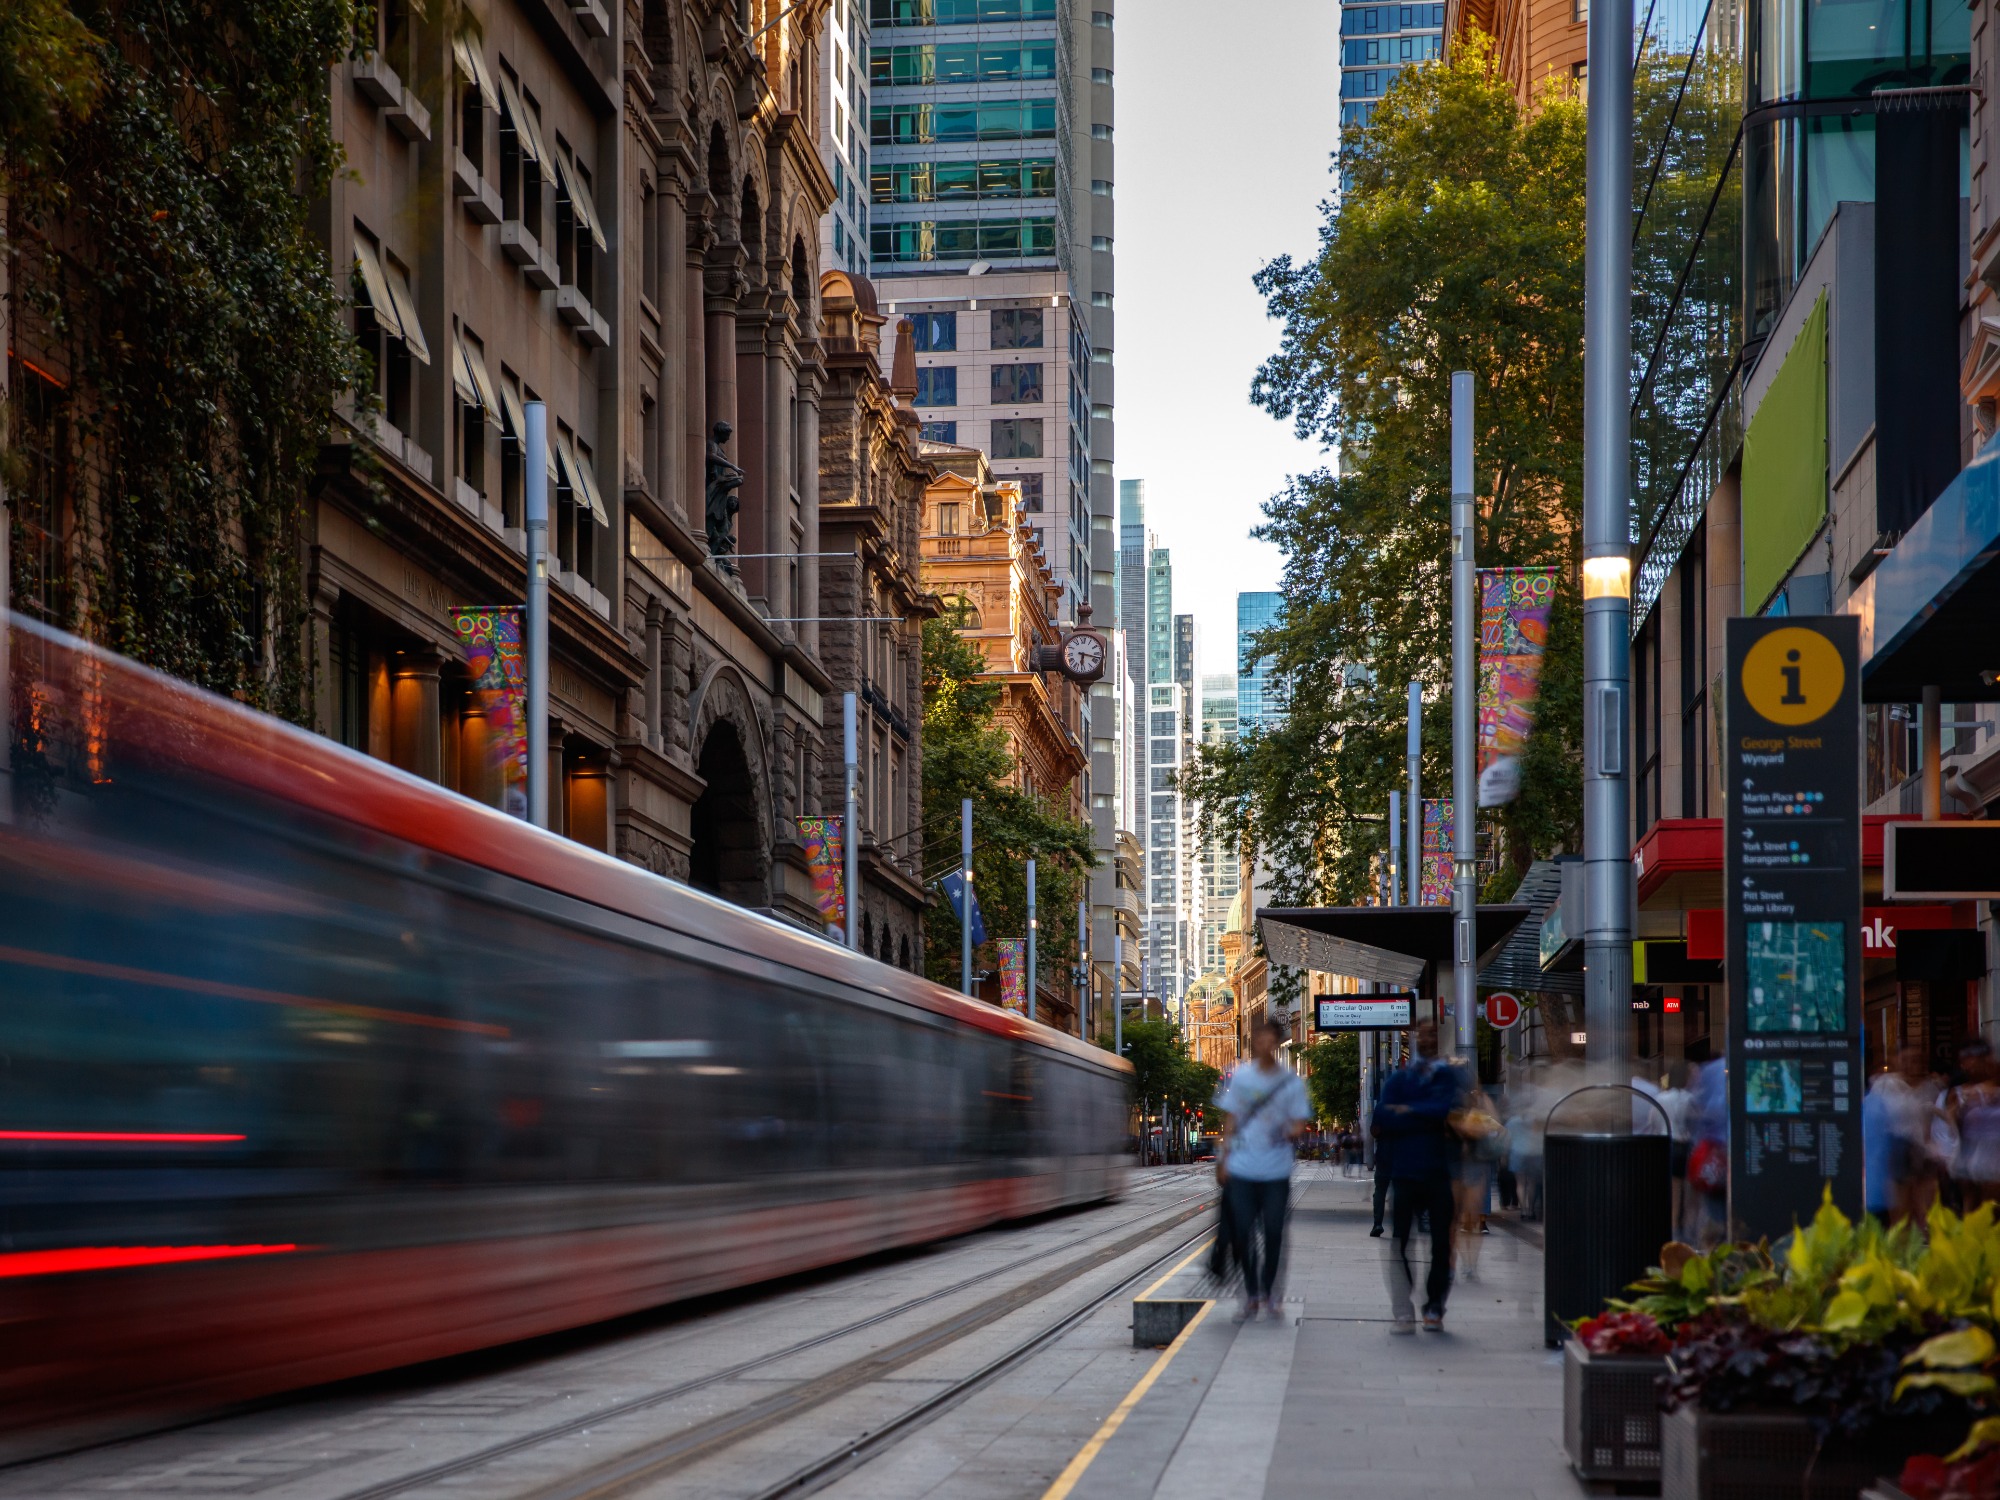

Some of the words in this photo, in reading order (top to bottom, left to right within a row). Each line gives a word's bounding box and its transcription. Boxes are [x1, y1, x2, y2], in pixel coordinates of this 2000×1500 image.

[1741, 736, 1785, 753] George
[1787, 736, 1822, 749] Street
[1741, 753, 1785, 766] Wynyard
[1742, 792, 1771, 802] Martin
[1771, 792, 1794, 802] Place
[1742, 805, 1765, 814] Town
[1766, 805, 1784, 814] Hall
[1762, 842, 1788, 851] Street
[1759, 891, 1784, 900] Street
[1743, 904, 1764, 913] State
[1765, 903, 1795, 916] Library
[1358, 1004, 1373, 1012] Quay
[1632, 1000, 1650, 1009] nab
[1496, 1000, 1510, 1021] L
[1578, 1034, 1586, 1042] H
